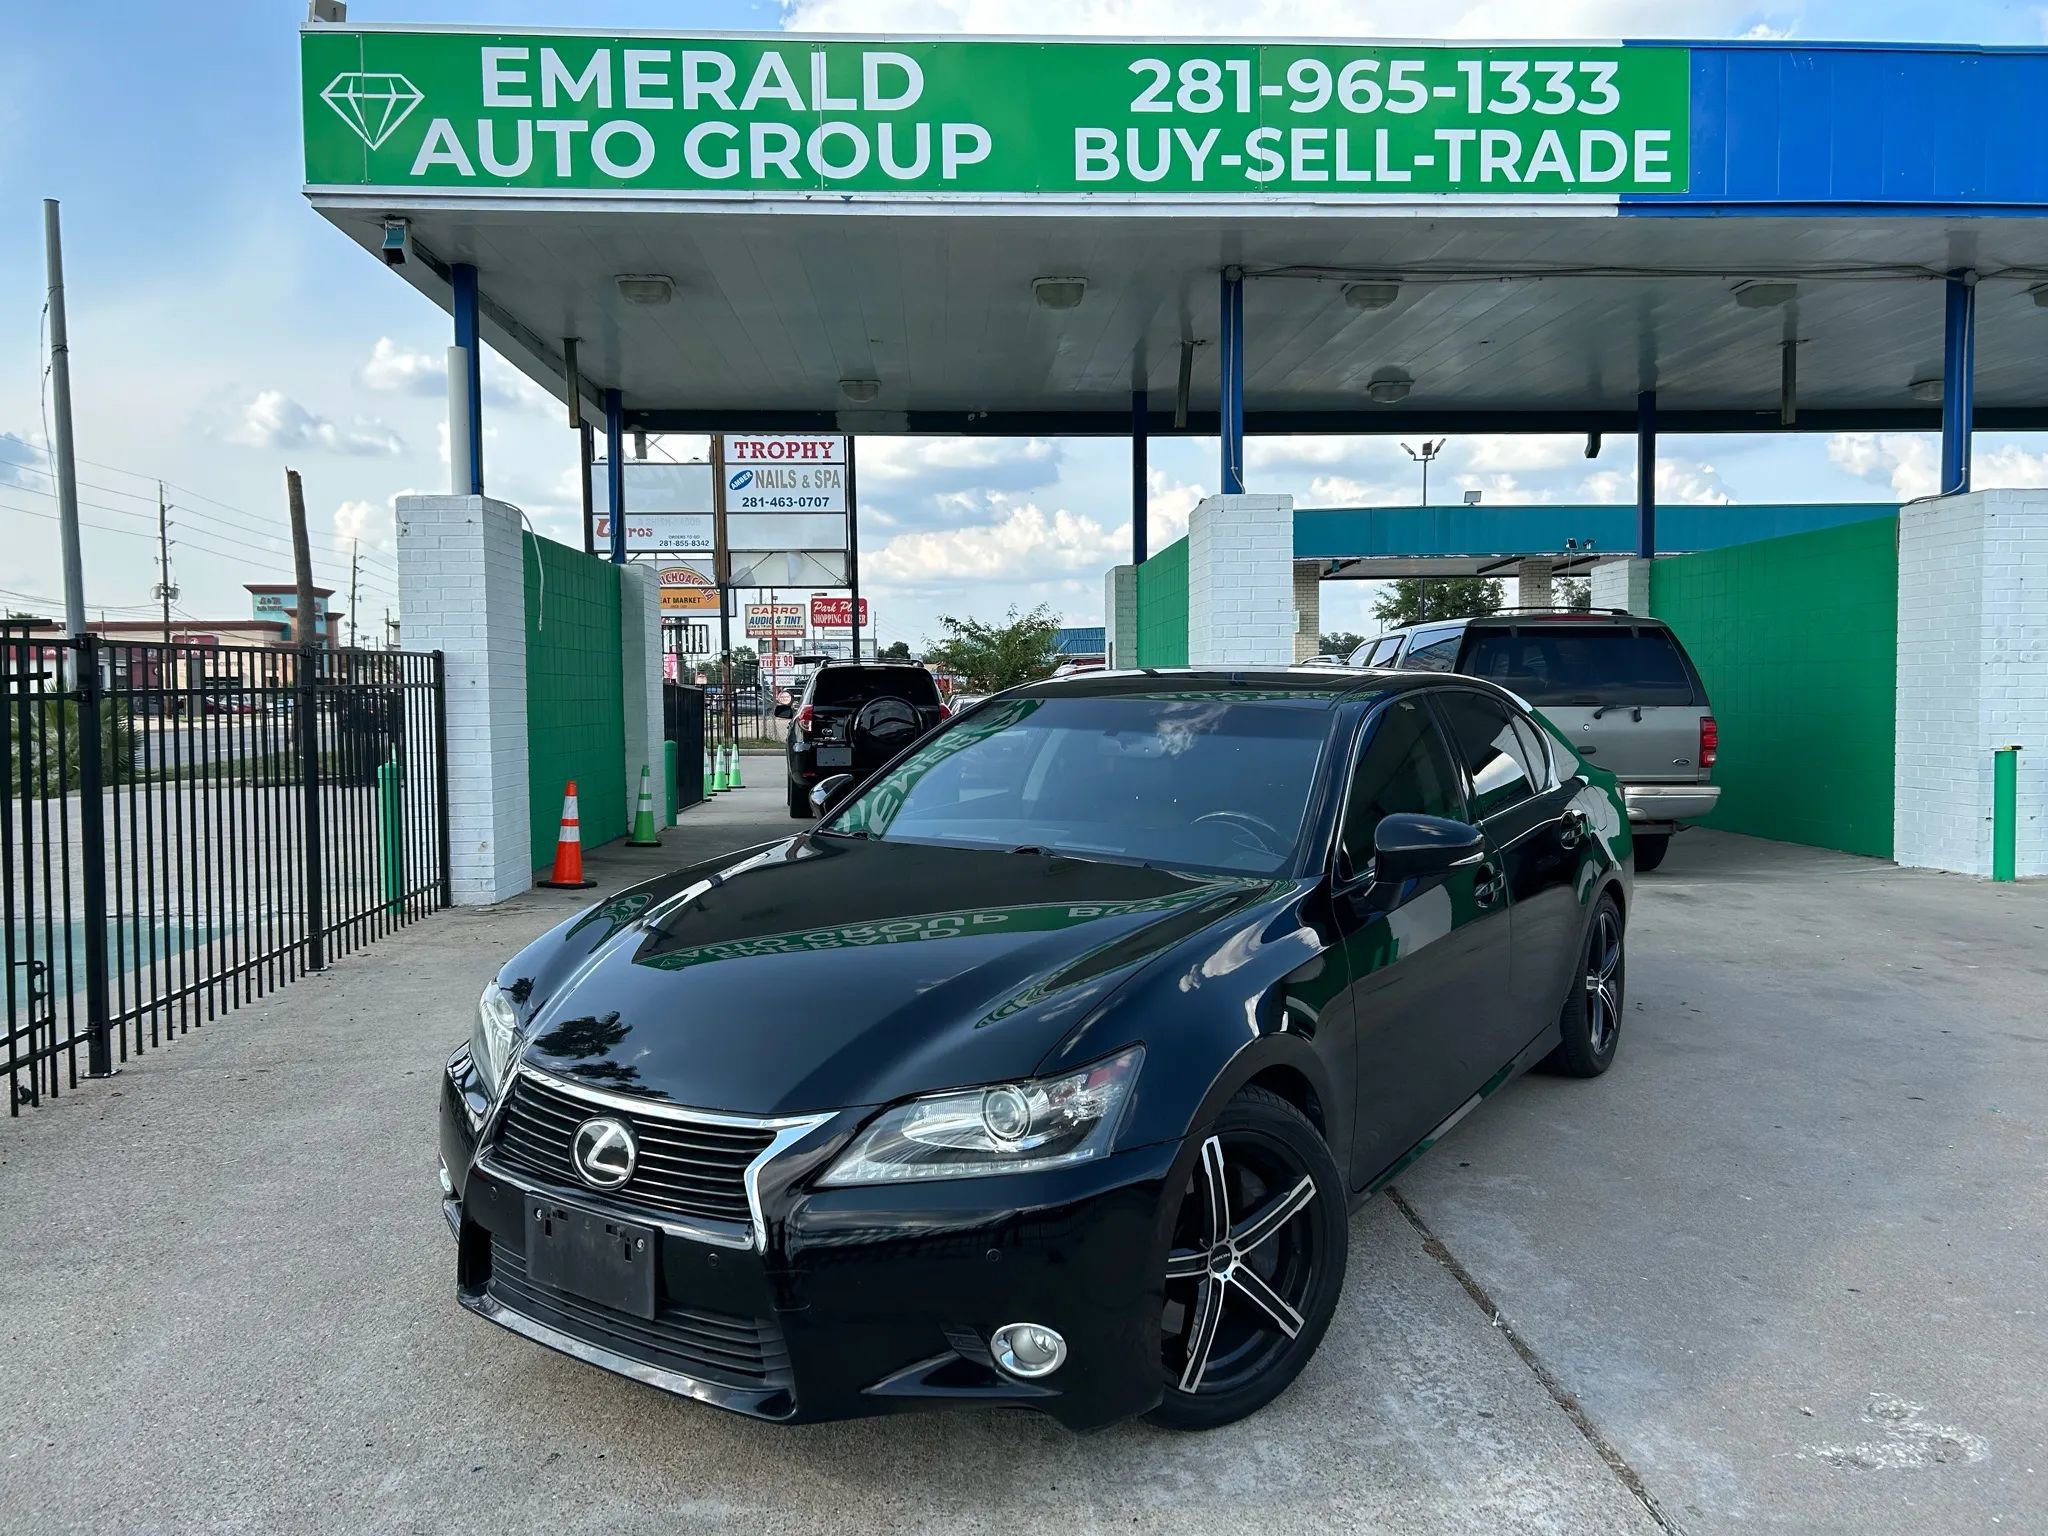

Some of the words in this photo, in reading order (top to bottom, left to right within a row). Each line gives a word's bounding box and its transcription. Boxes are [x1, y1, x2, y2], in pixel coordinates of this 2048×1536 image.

[480, 46, 924, 112] EMERALD
[1127, 58, 1621, 116] 281-965-1333
[409, 118, 655, 179] AUTO
[683, 121, 992, 181] GROUP
[1074, 127, 1672, 185] BUY-SELL-TRADE
[734, 441, 835, 459] TROPHY
[730, 471, 753, 490] AMBER
[755, 469, 797, 489] NAILS
[801, 474, 811, 489] &
[814, 469, 841, 489] SPA
[742, 496, 830, 508] 281-463-0707
[751, 607, 799, 615] CARRO
[813, 601, 837, 613] Park
[840, 601, 865, 613] Ple
[775, 616, 782, 625] &
[784, 616, 802, 625] TINT
[813, 613, 842, 624] SHOPPING
[843, 614, 866, 624] CEER
[783, 655, 793, 667] 99
